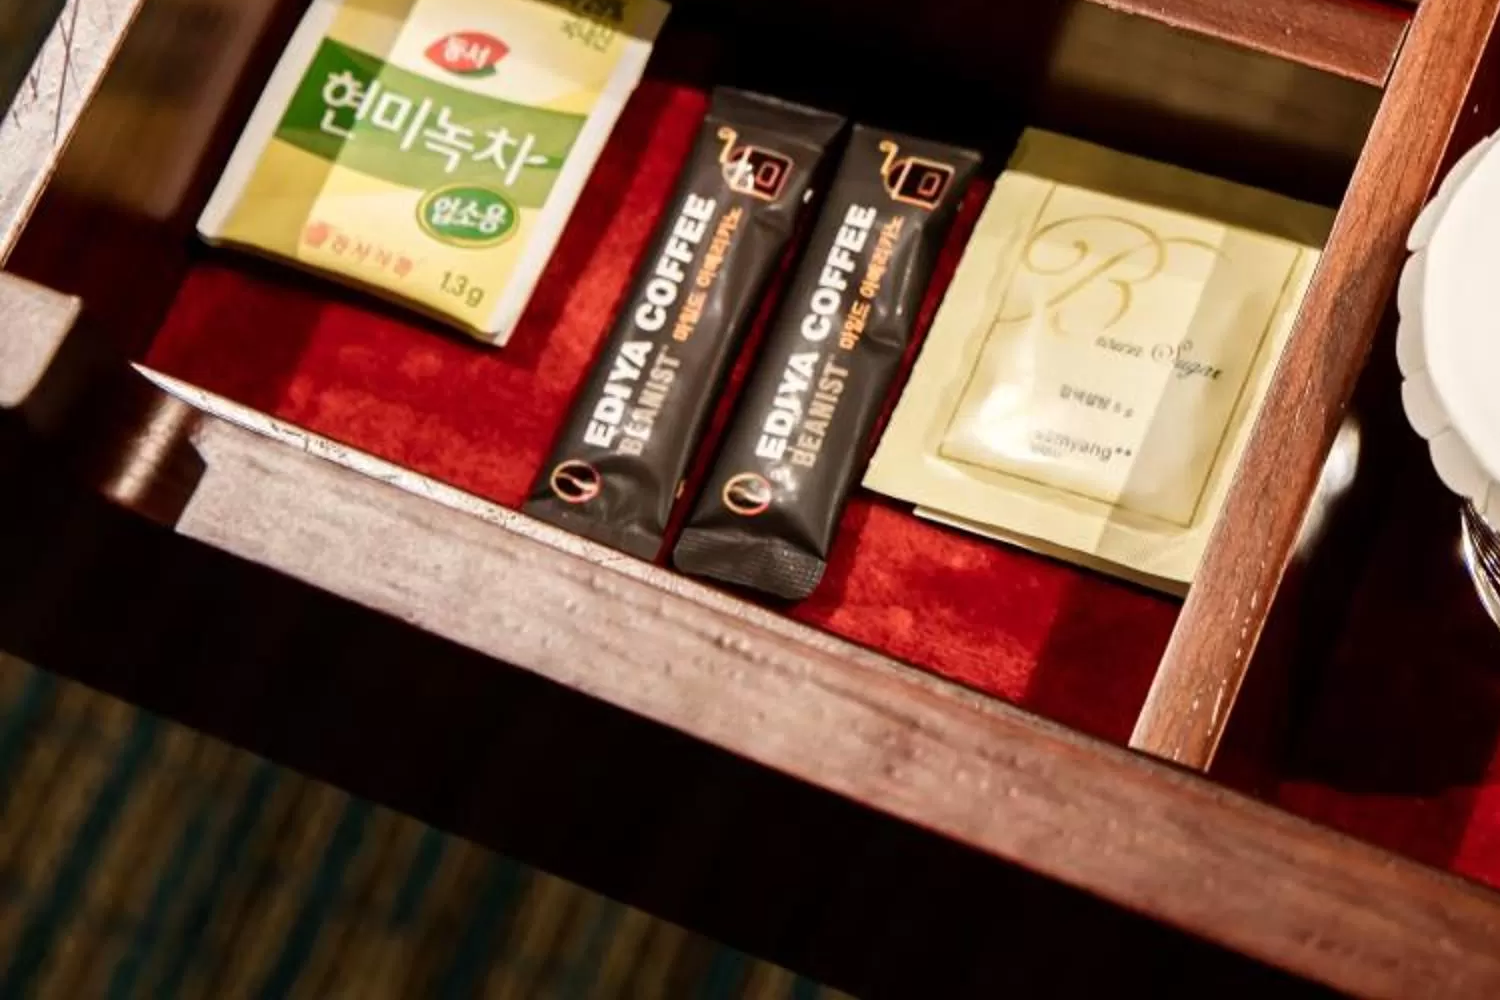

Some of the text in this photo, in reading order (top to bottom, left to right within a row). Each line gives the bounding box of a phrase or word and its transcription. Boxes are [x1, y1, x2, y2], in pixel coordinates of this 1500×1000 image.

[320, 69, 549, 187] 현미녹차
[430, 196, 506, 234] 업소용
[584, 193, 717, 449] EDIYA COFFEE
[755, 204, 877, 460] EDIYA COFFEE
[616, 350, 681, 456] BEANIST
[791, 358, 849, 468] BEANIST
